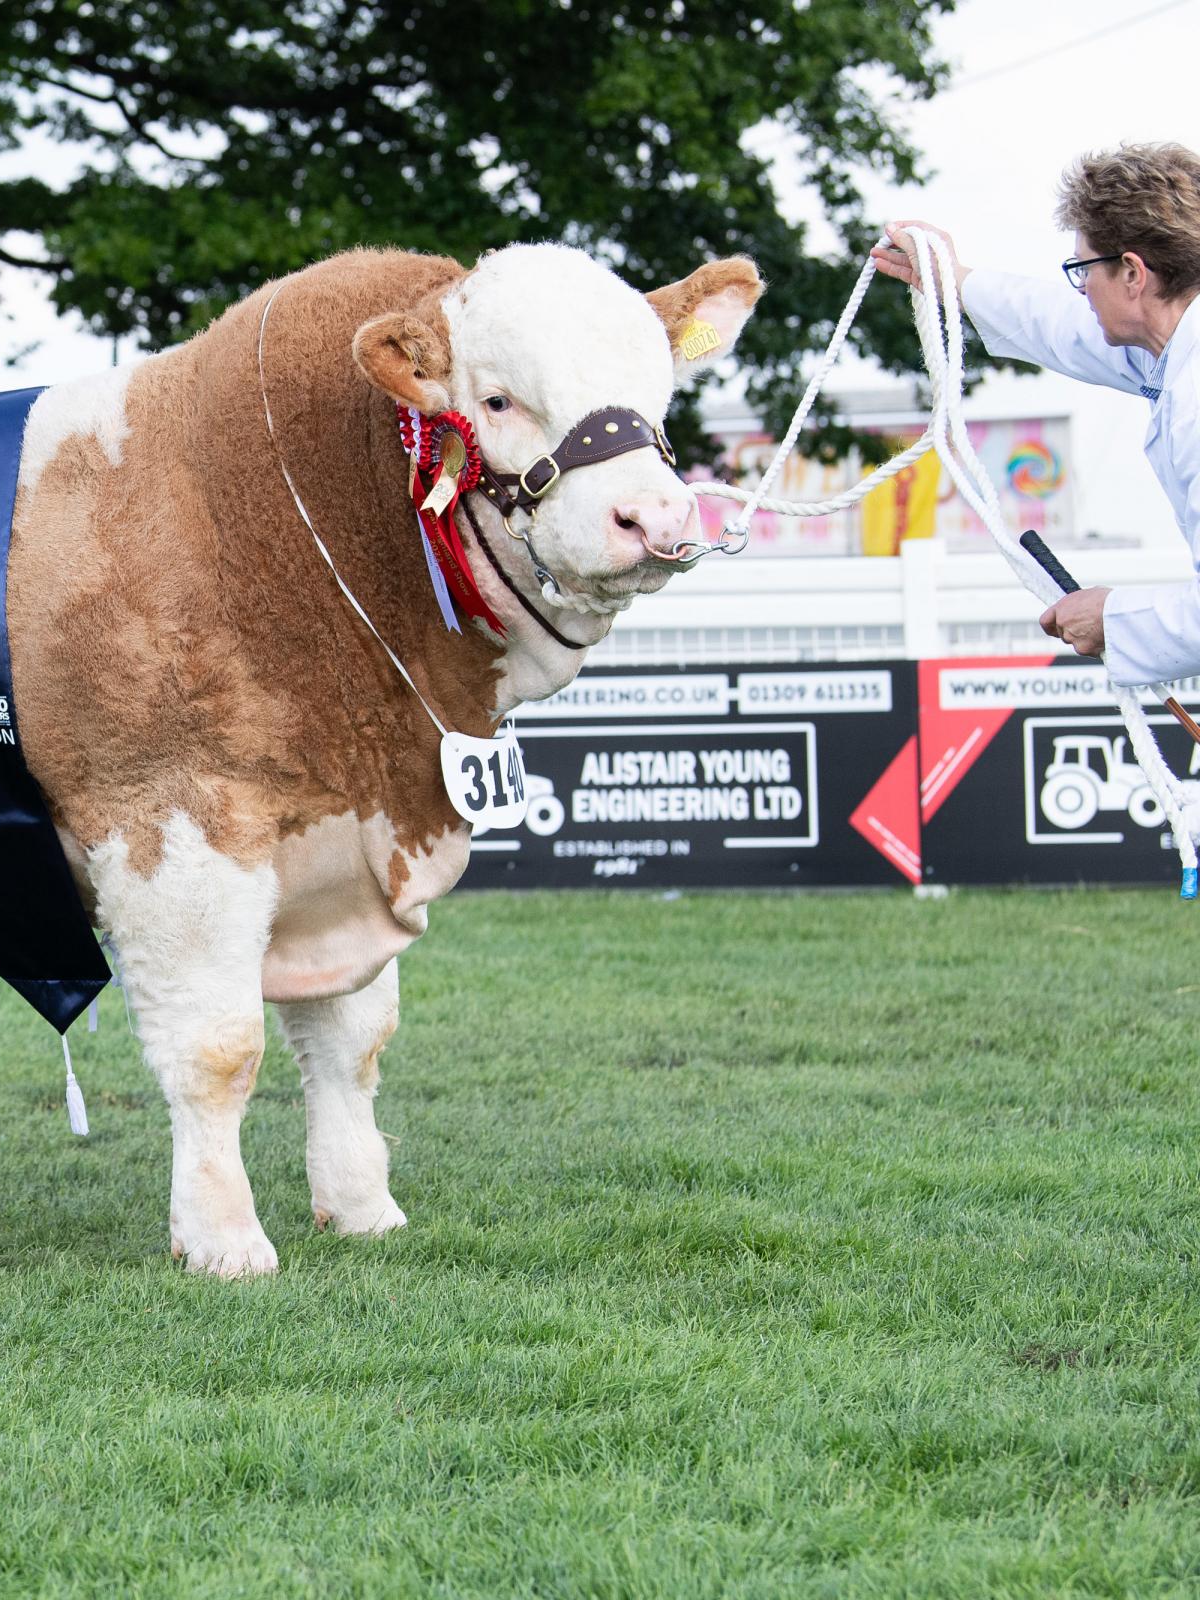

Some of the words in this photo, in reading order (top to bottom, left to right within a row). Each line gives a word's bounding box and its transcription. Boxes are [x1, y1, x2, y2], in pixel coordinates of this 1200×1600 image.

[749, 685, 806, 701] 01309
[815, 683, 881, 700] 611335
[580, 751, 697, 786] ALISTAIR
[700, 749, 791, 784] YOUNG
[572, 787, 749, 822] ENGINEERING
[754, 786, 803, 820] LTD
[553, 839, 668, 857] ESTABLISHED
[670, 839, 691, 856] IN
